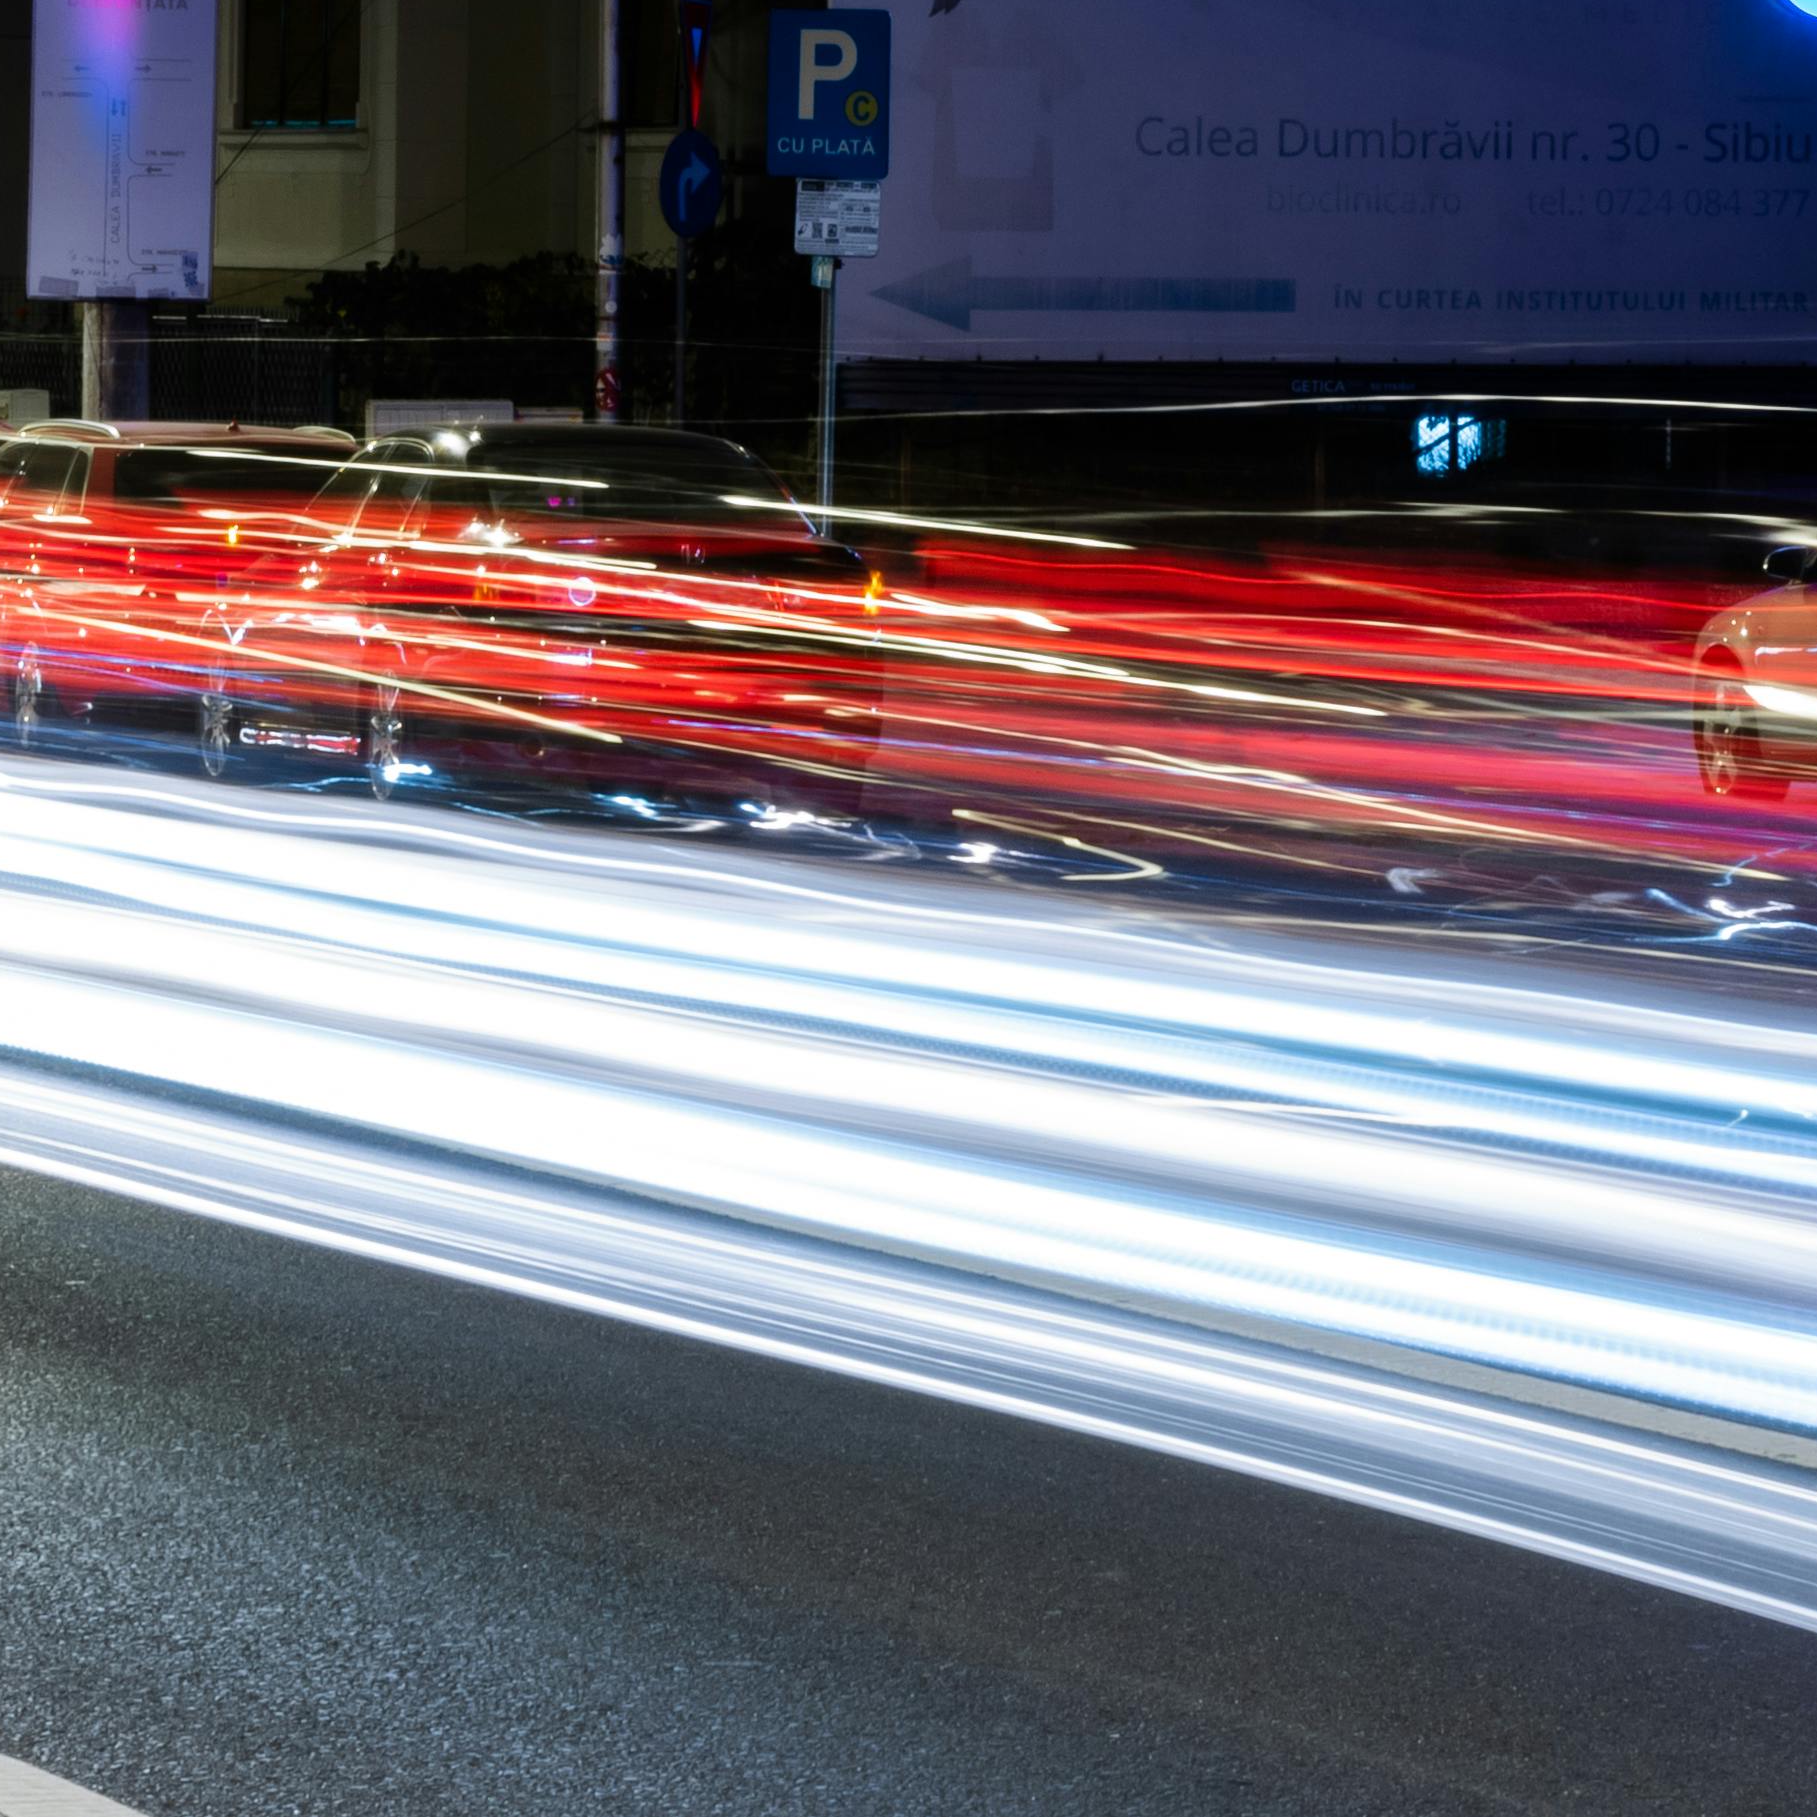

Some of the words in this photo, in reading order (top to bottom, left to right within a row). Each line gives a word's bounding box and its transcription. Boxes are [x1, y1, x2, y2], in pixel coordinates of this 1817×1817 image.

[798, 28, 858, 120] P
[777, 138, 805, 154] CU
[811, 135, 876, 155] PLATĂ
[1135, 117, 1259, 160] Calea
[1278, 118, 1514, 162] Dumbrăvii
[1532, 131, 1590, 162] nr.
[1608, 123, 1660, 162] 30
[1704, 122, 1813, 164] Sibiu
[1267, 184, 1461, 216] bioclinica.ro
[1527, 185, 1583, 217] tel.:
[1597, 187, 1674, 217] 0724
[1684, 188, 1742, 217] 084
[1751, 189, 1811, 218] 377
[1334, 282, 1363, 309] ÎN
[1377, 288, 1483, 310] CURTEA
[1496, 289, 1687, 312] INSTITUTULUI
[1700, 291, 1809, 313] MILITAR
[1290, 378, 1347, 394] GETICA
